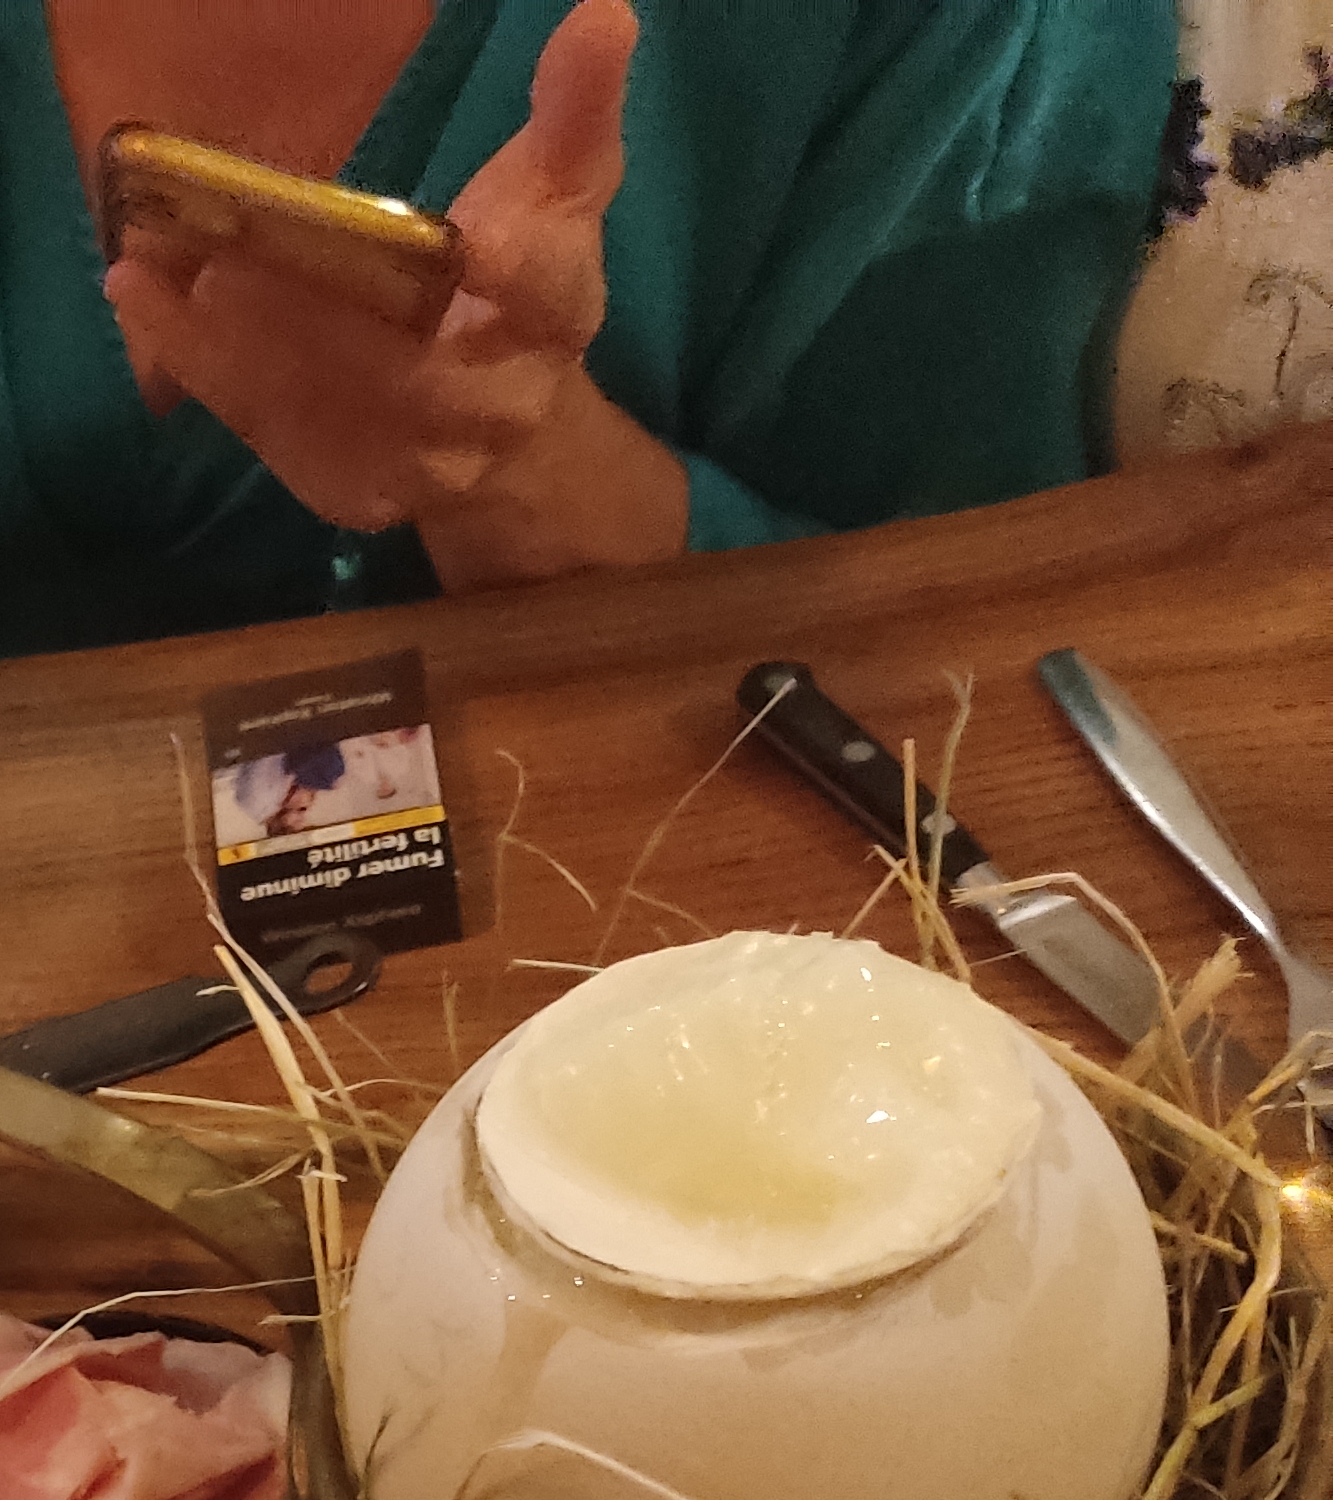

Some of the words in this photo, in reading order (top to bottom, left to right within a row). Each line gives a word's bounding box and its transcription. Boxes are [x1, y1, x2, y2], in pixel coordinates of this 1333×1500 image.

[307, 832, 409, 869] fertilité
[413, 825, 442, 845] la
[357, 849, 445, 879] Fumer
[240, 866, 351, 902] diminue
